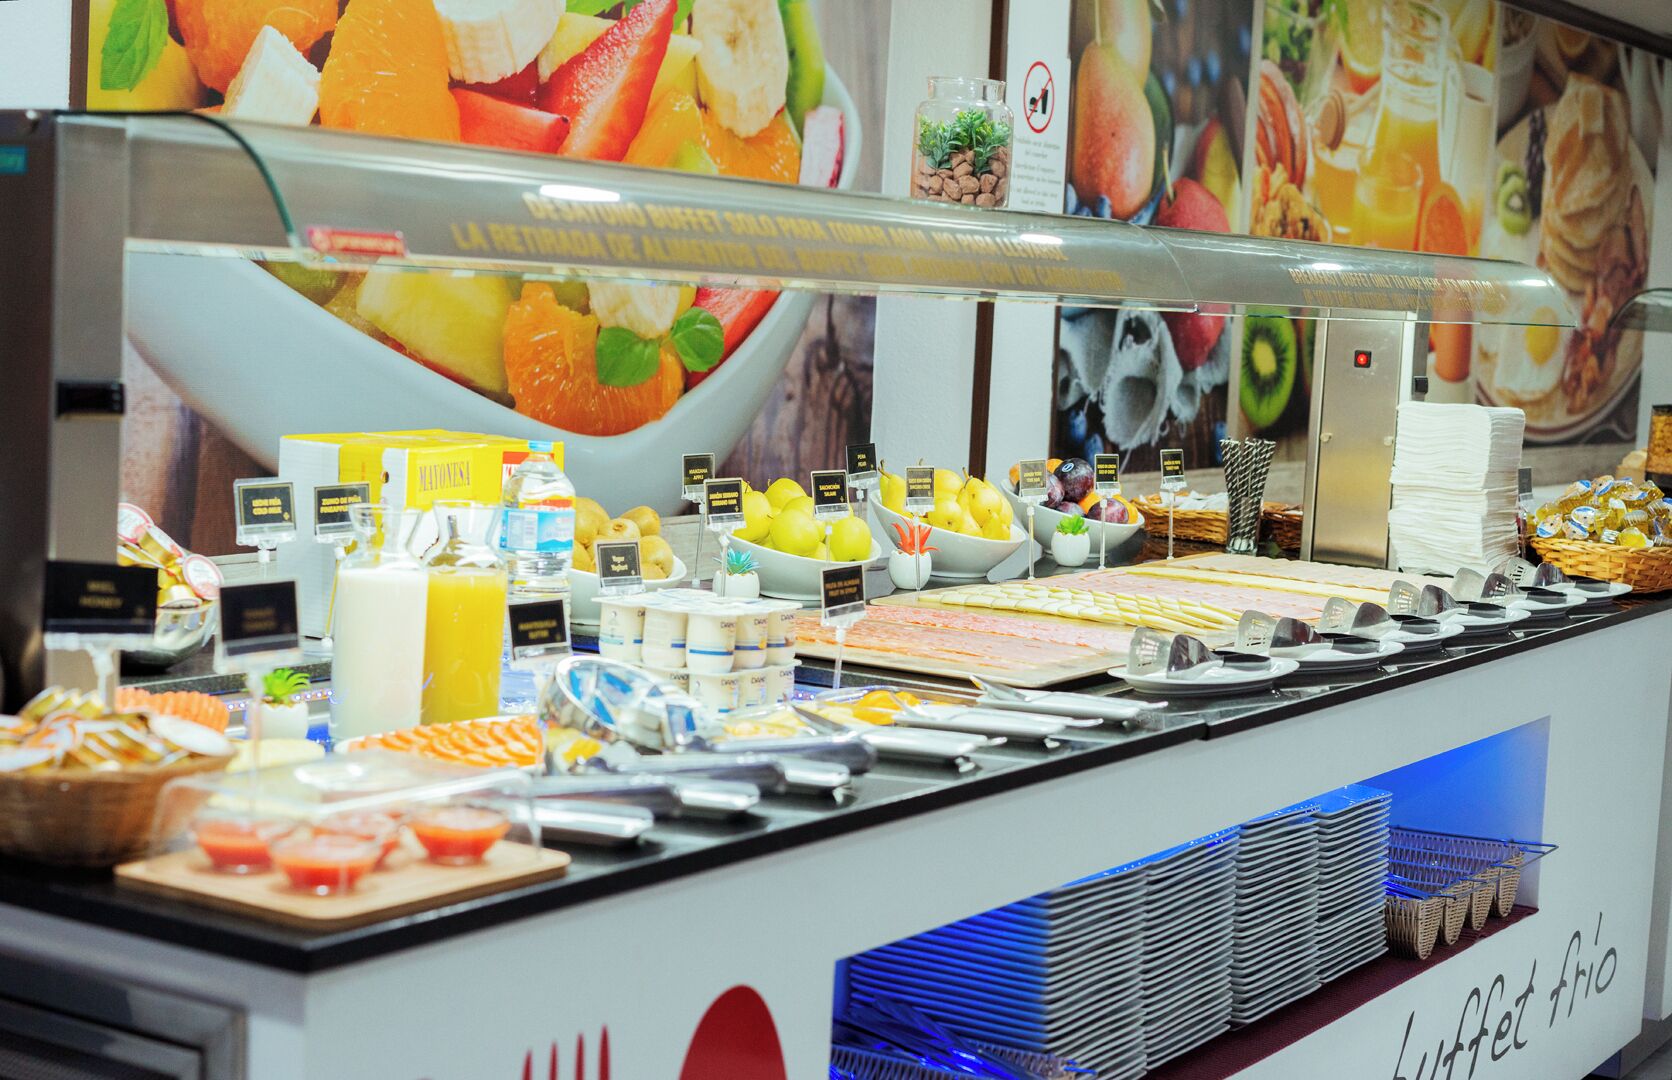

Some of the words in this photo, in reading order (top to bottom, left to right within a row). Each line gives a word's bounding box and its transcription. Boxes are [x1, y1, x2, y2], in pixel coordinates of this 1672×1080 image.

[522, 192, 647, 228] DESAYUNO
[645, 203, 723, 233] BUFFET
[723, 210, 778, 237] SOLO
[776, 215, 829, 241] PARA
[826, 221, 891, 246] TOMAR
[932, 230, 960, 252] NO
[955, 232, 998, 256] PARA
[451, 222, 488, 251] LA
[487, 223, 608, 258] RETIRADA
[605, 232, 644, 261] DE
[641, 235, 757, 268] ALIMENTOS
[1288, 268, 1337, 286] BREAKFAST
[1337, 271, 1371, 288] BUFFET
[1369, 273, 1392, 289] ONLY
[1389, 274, 1405, 289] TO
[1400, 275, 1424, 290] TAKE
[1456, 279, 1475, 293] NOT
[418, 461, 471, 492] MAYONESA
[340, 496, 347, 504] DE
[1393, 958, 1536, 1080] buffet
[1550, 911, 1617, 1028] frío
